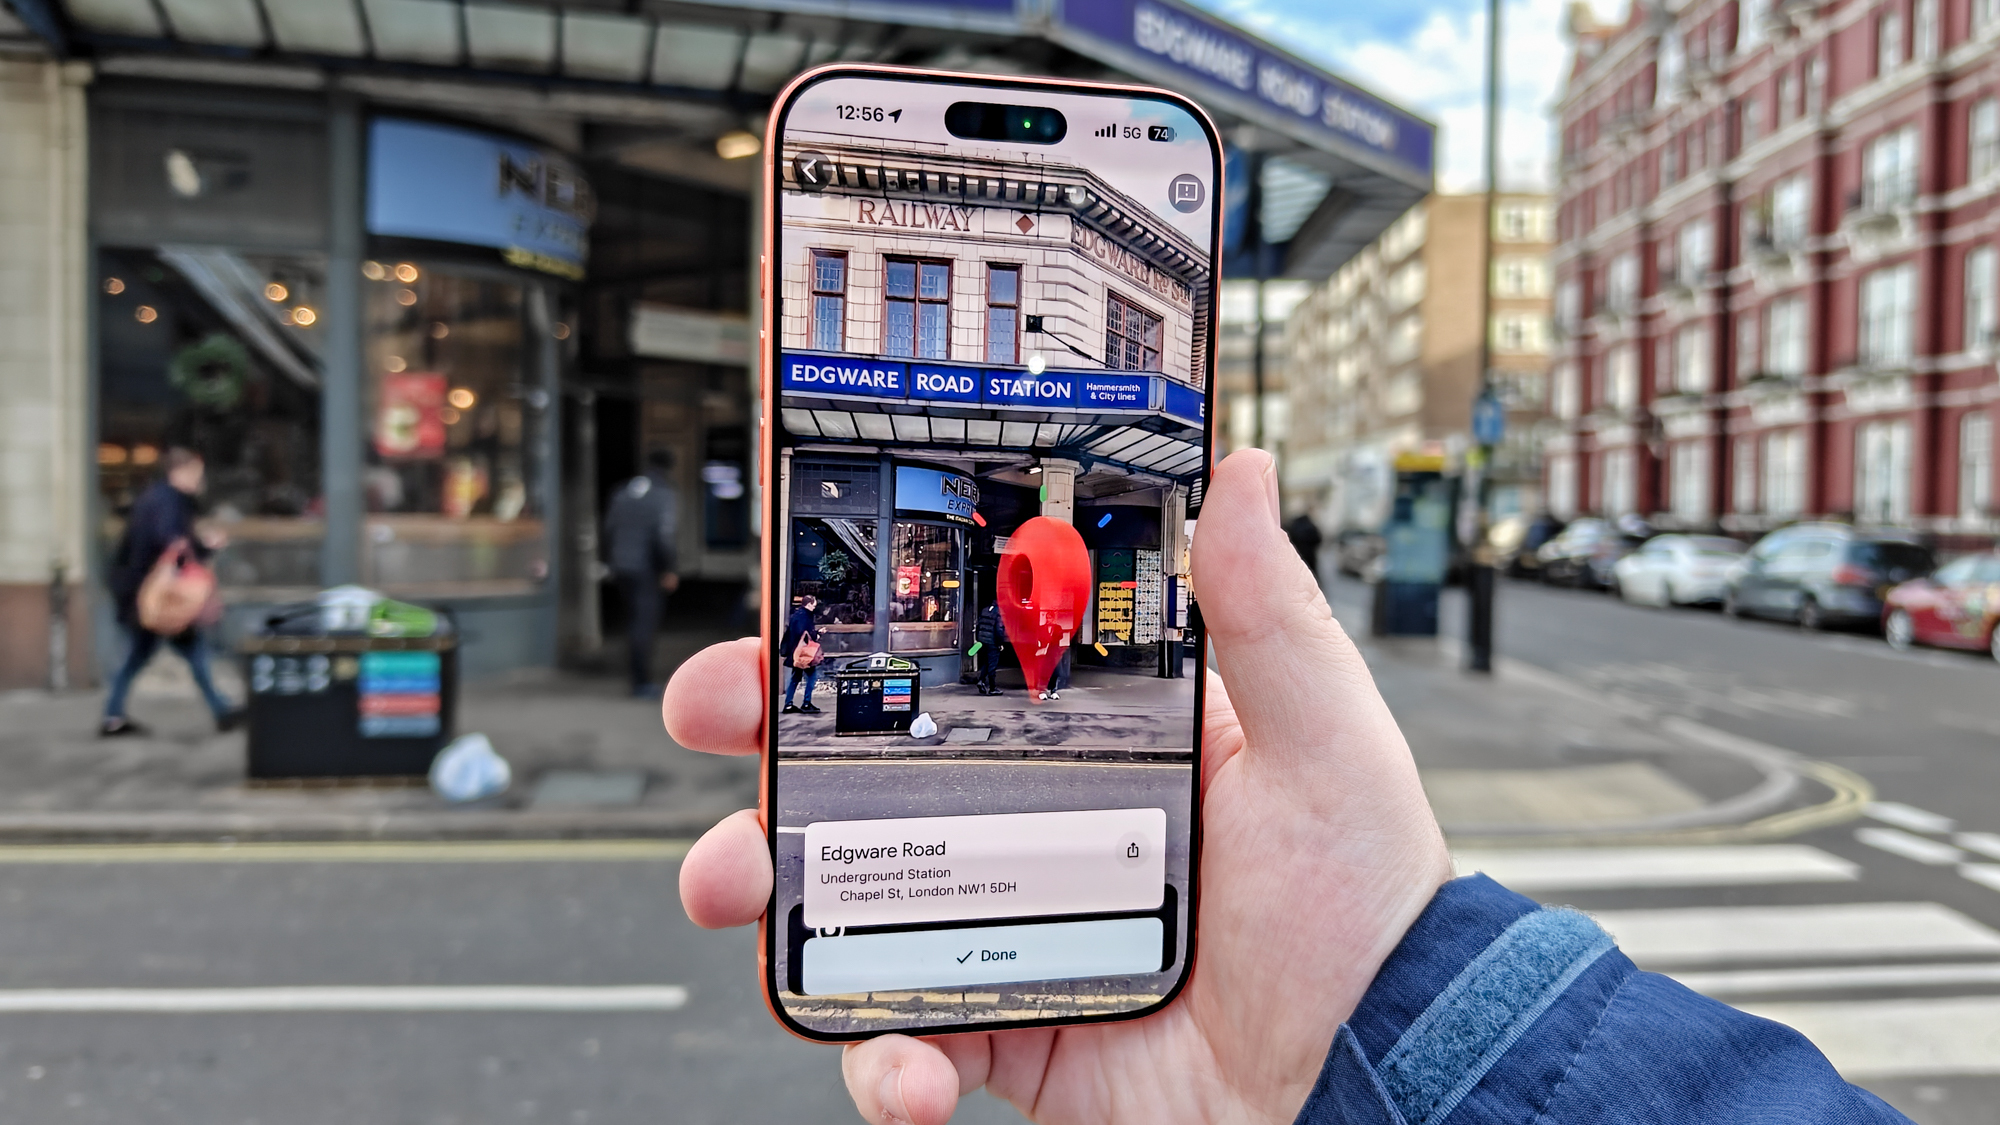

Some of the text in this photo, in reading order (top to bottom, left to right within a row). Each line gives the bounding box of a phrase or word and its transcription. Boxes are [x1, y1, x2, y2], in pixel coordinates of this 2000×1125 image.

[836, 105, 884, 122] 12:56
[1123, 126, 1168, 140] 5G 74
[857, 199, 977, 232] RAILWAY
[791, 364, 1071, 399] EDGWARE ROAD STATION
[1086, 382, 1140, 392] Hammersmith
[1090, 392, 1136, 401] & City lines
[821, 841, 946, 865] Edgware Road
[820, 867, 951, 885] Underground Station
[840, 881, 1017, 902] Chapel St, London NW1 5DH
[981, 949, 1017, 962] Done
